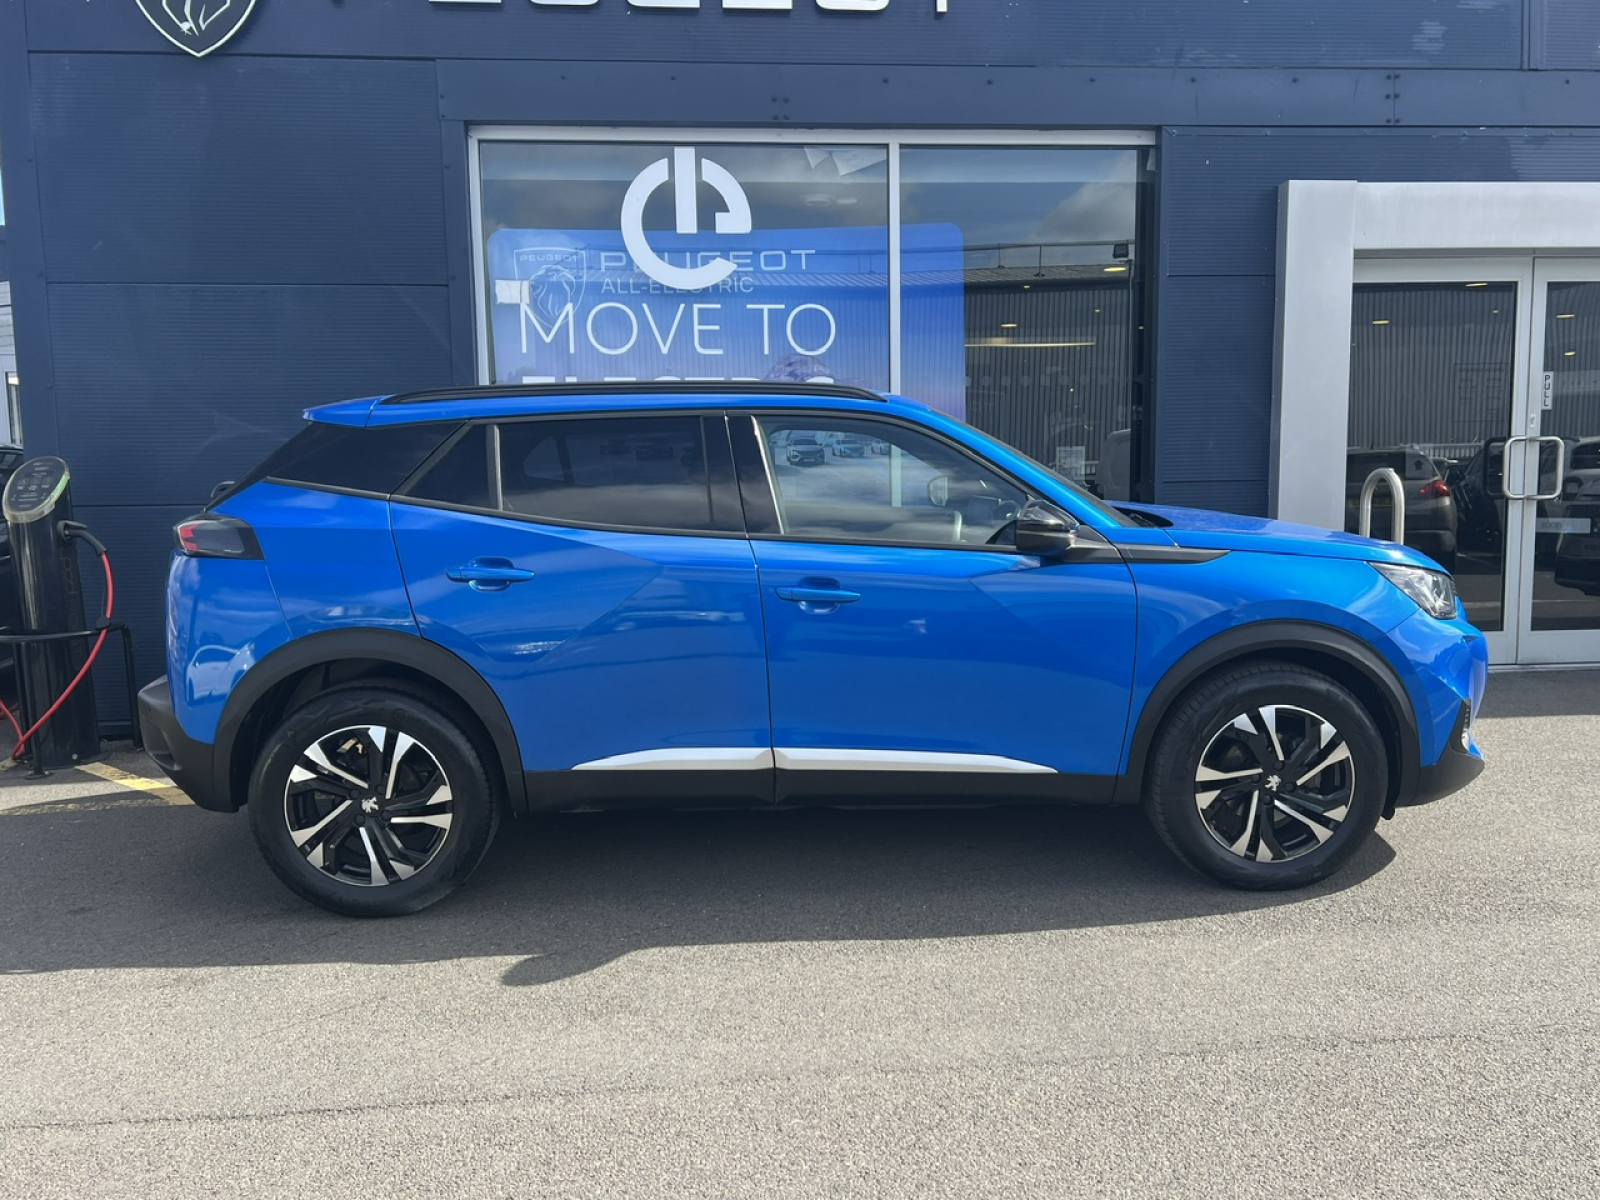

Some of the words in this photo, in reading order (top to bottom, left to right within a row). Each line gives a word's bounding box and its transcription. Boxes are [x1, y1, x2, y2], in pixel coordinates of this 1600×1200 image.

[600, 249, 816, 272] PUGEOT
[519, 302, 724, 355] MOVE
[746, 303, 836, 356] TO
[1543, 374, 1551, 407] PULL
